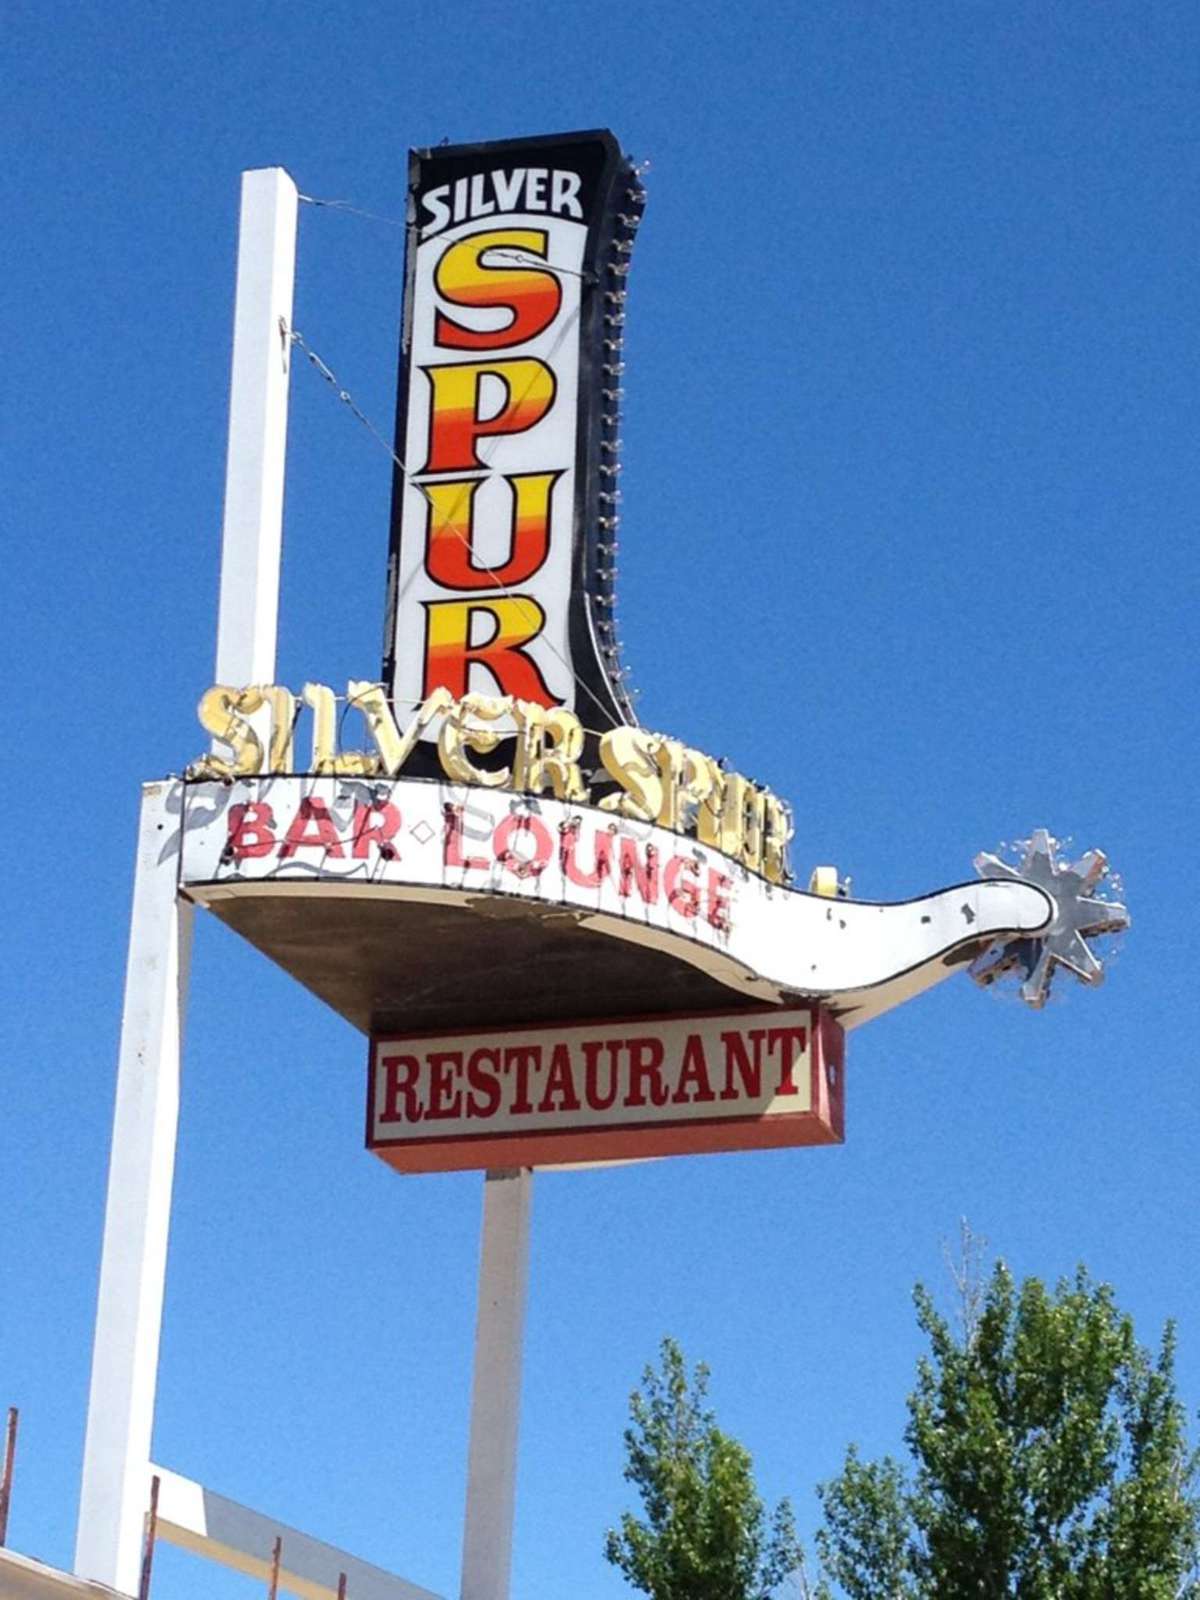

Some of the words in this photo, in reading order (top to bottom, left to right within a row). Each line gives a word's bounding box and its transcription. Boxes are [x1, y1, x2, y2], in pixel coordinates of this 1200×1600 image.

[420, 167, 584, 239] SILVER
[411, 227, 569, 711] SPUR
[226, 796, 402, 862] BAR
[443, 802, 735, 933] LOUNGE
[379, 1026, 807, 1124] RESTAURANT
